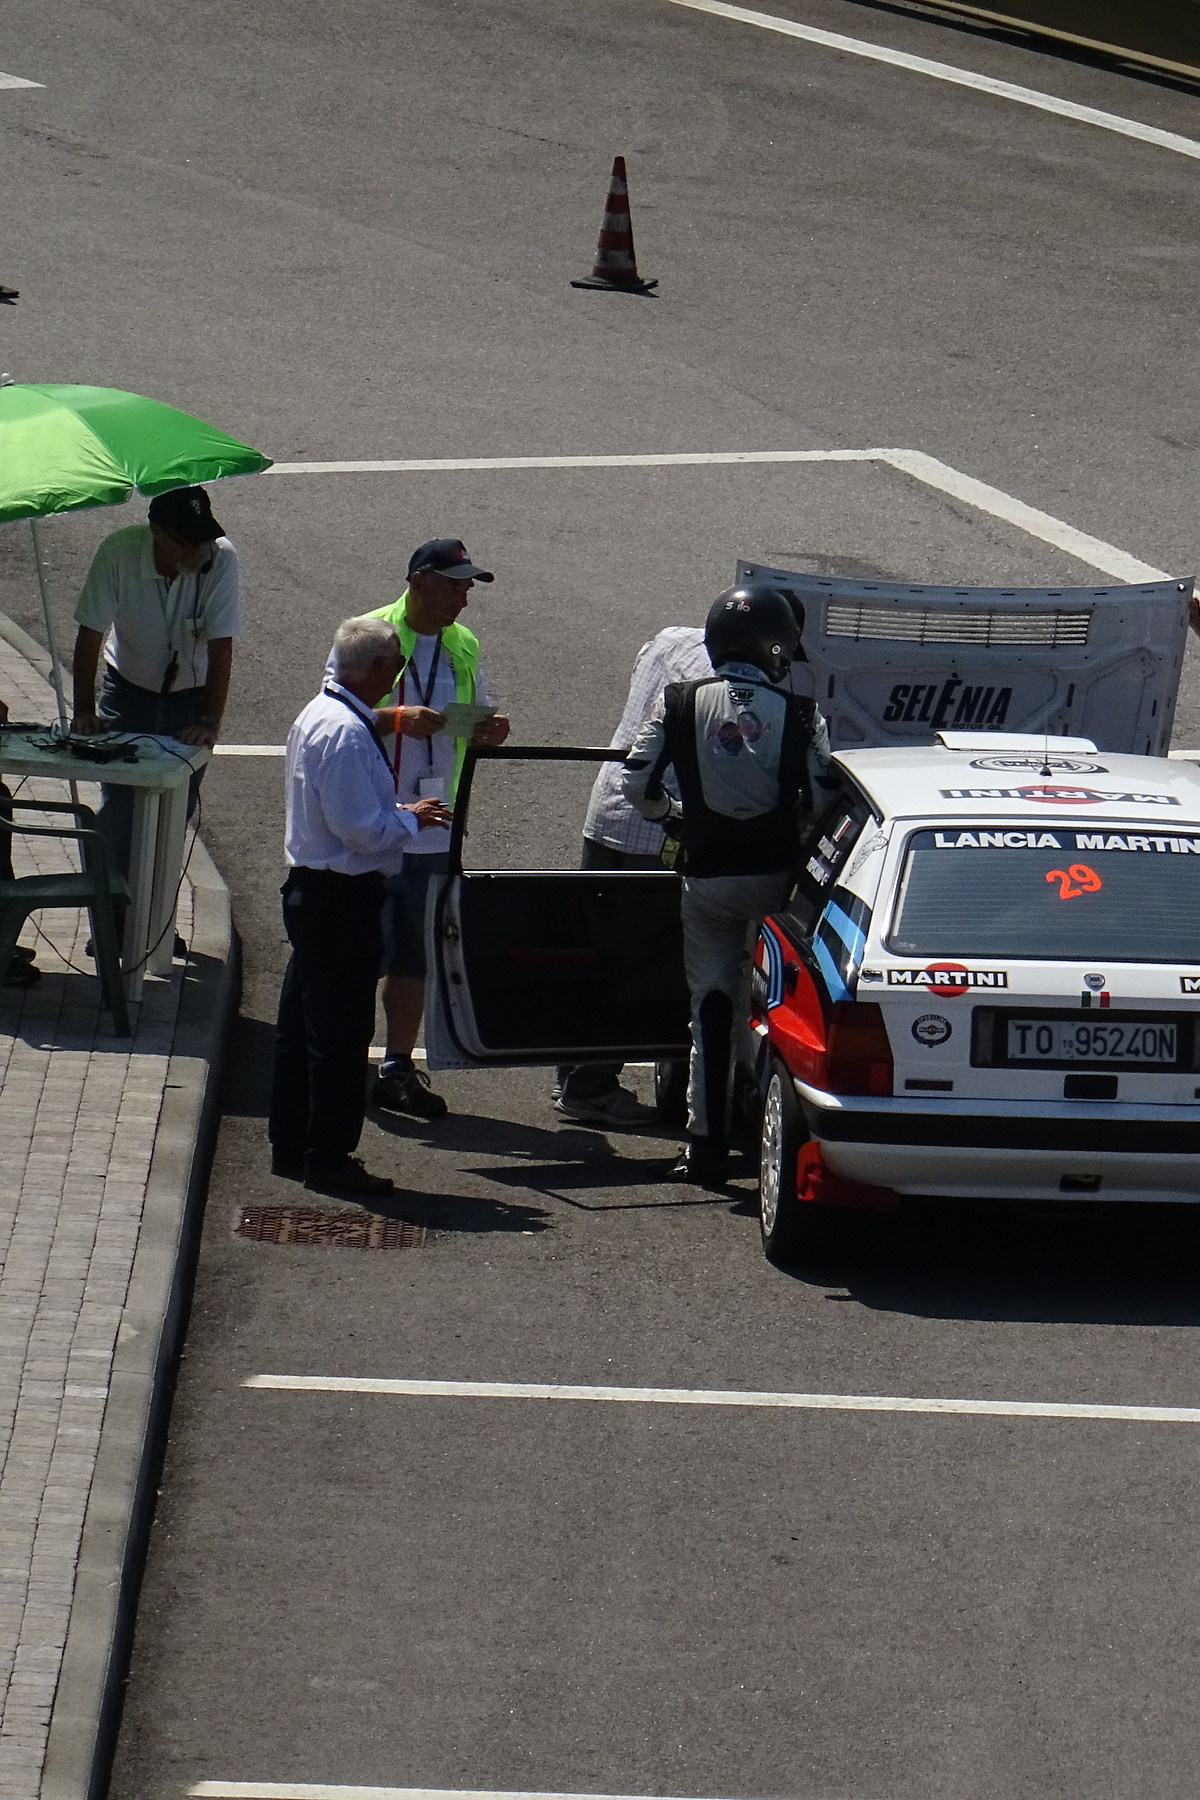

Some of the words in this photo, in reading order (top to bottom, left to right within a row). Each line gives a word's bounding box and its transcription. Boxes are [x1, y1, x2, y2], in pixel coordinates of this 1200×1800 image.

[950, 722, 984, 730] MOTOR
[950, 789, 1170, 804] MARTINI
[934, 832, 1062, 849] LANCIA
[1045, 863, 1102, 900] 29
[890, 970, 1004, 986] MARTINI
[1014, 1024, 1053, 1054] TO
[1075, 1026, 1174, 1058] 95240N
